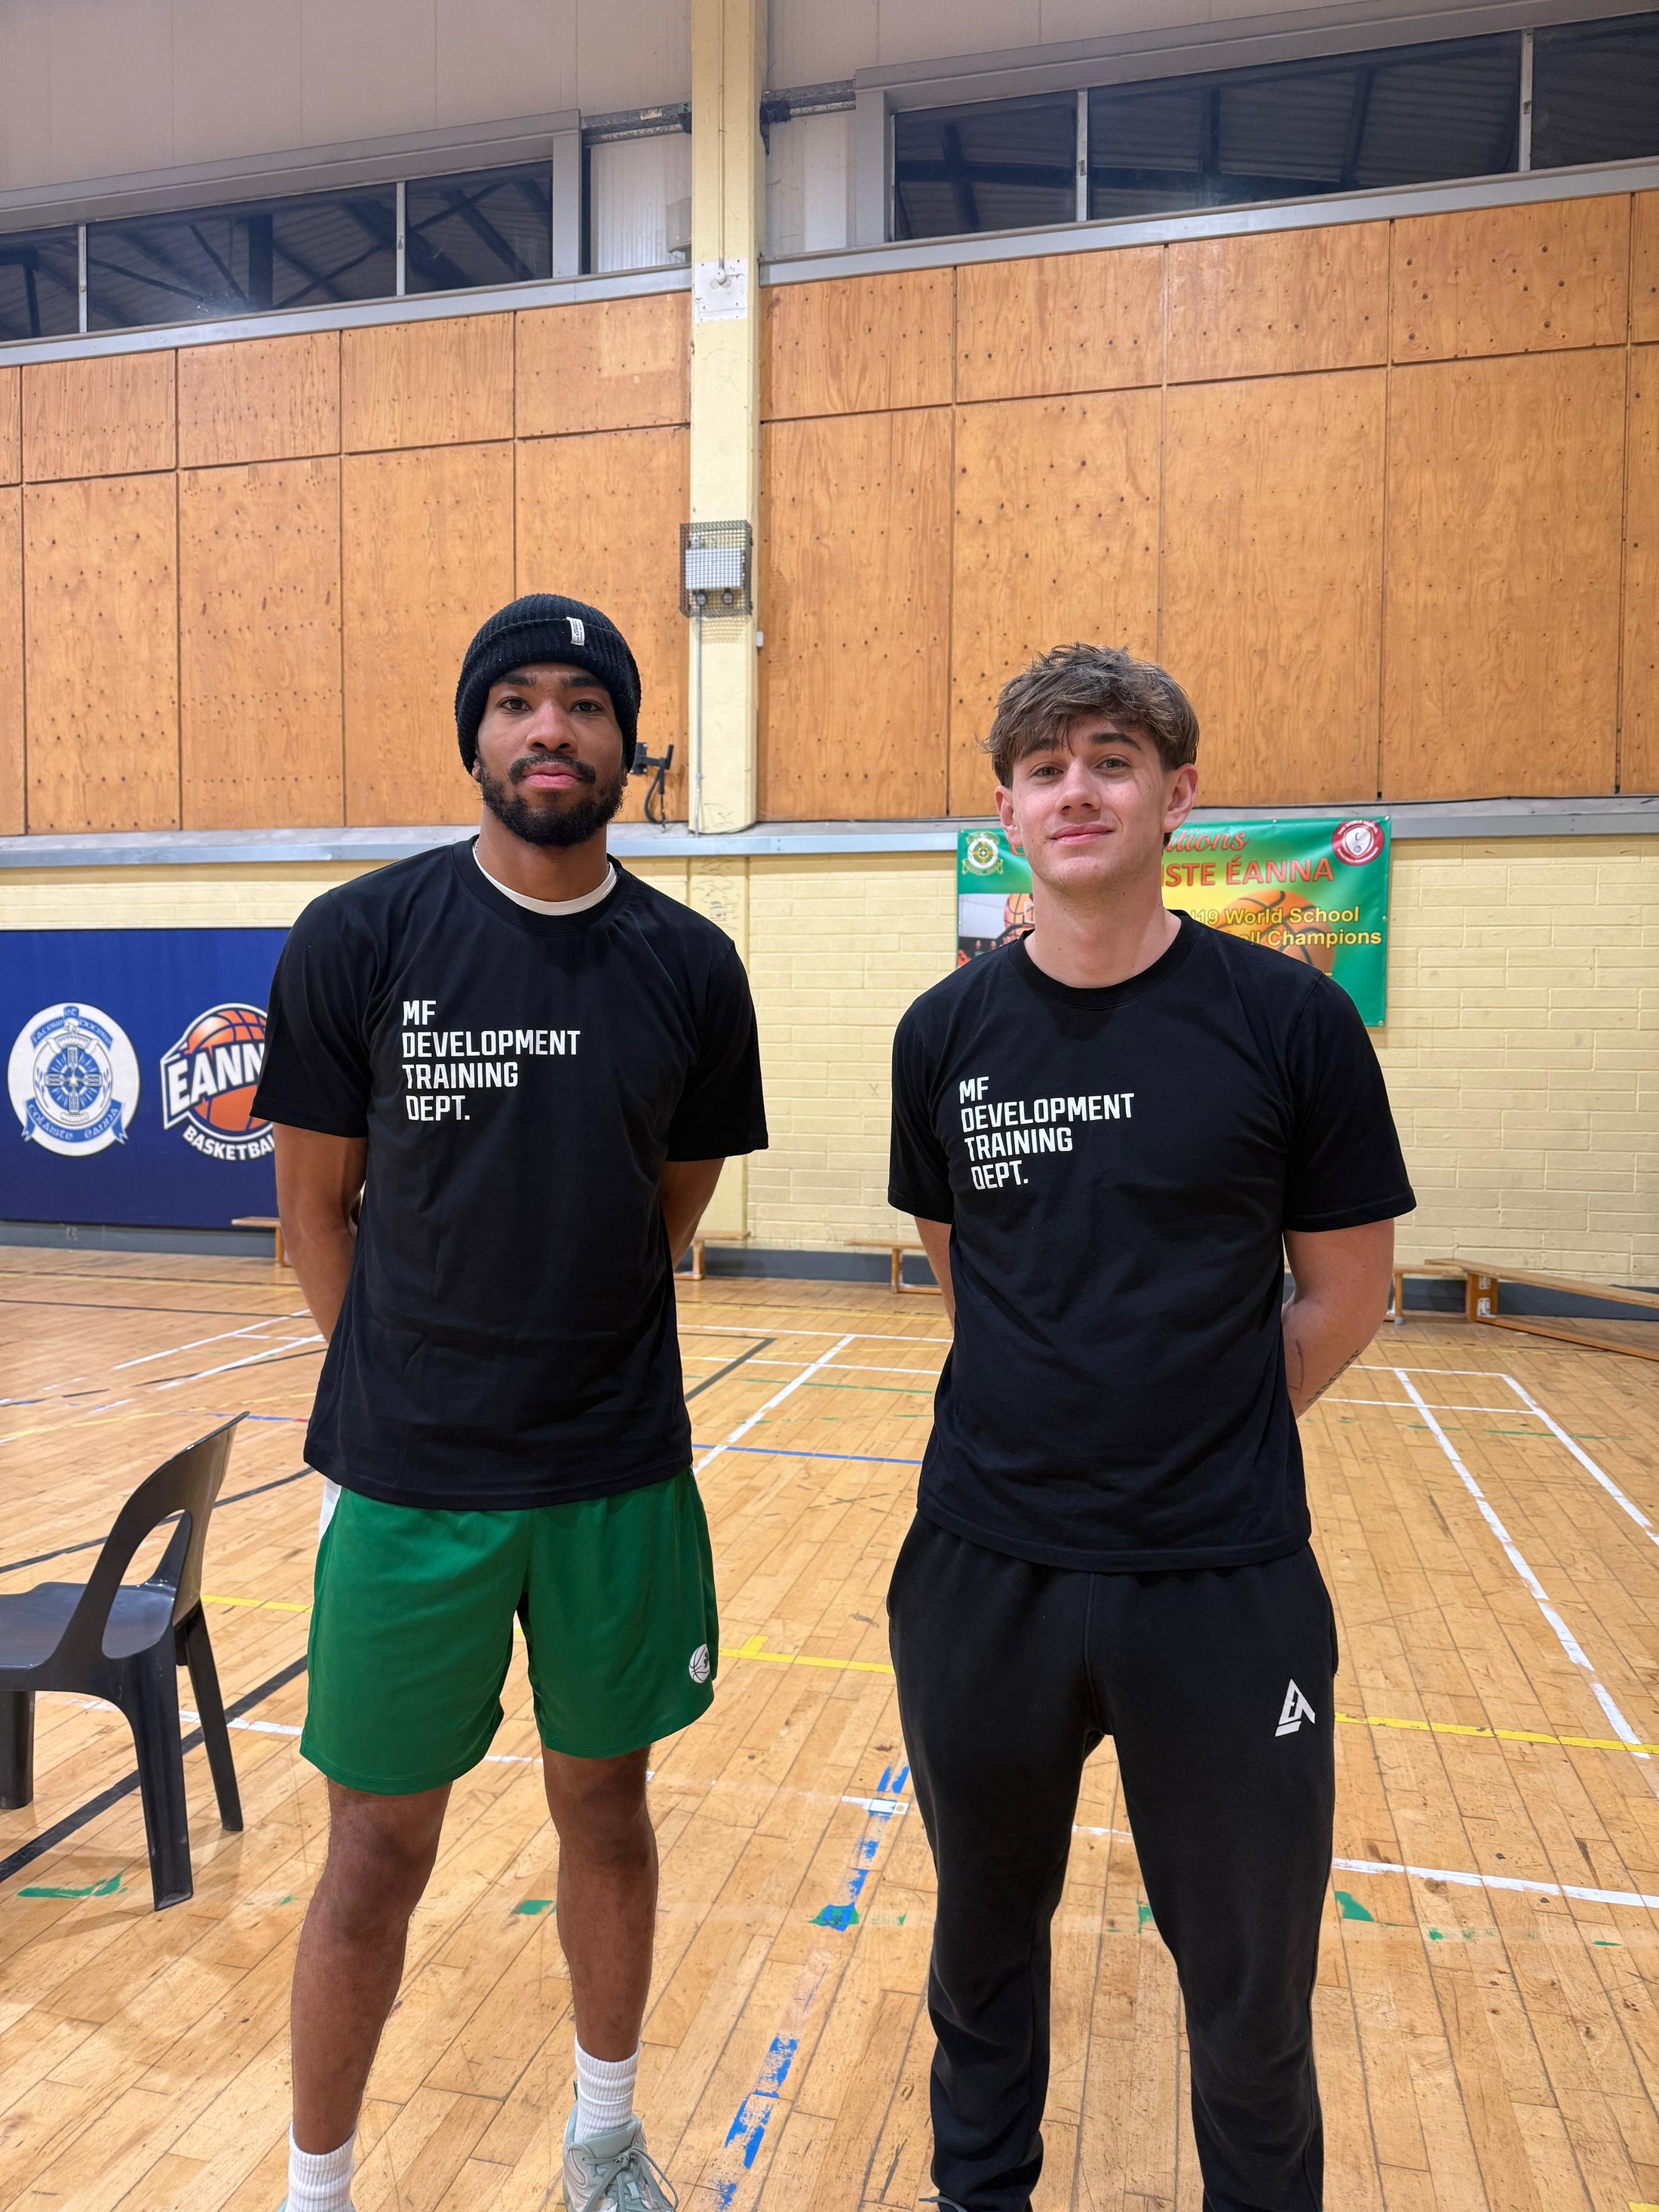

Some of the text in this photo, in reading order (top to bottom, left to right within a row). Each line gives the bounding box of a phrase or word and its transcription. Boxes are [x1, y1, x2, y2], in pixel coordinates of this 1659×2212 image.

[1166, 828, 1250, 852] tions
[1226, 854, 1334, 885] ÉANNA
[1224, 908, 1282, 925] World
[1289, 906, 1359, 923] School
[1267, 928, 1382, 949] Champions
[403, 1000, 437, 1026] MF
[402, 1029, 581, 1057] DEVELOPMENT
[402, 1062, 518, 1089] TRAINING
[959, 1076, 989, 1104] MF
[406, 1095, 470, 1121] DEPT.
[961, 1093, 1135, 1133] DEVELOPMENT
[964, 1127, 1073, 1161] TRAINING
[971, 1160, 1029, 1190] DEPT.
